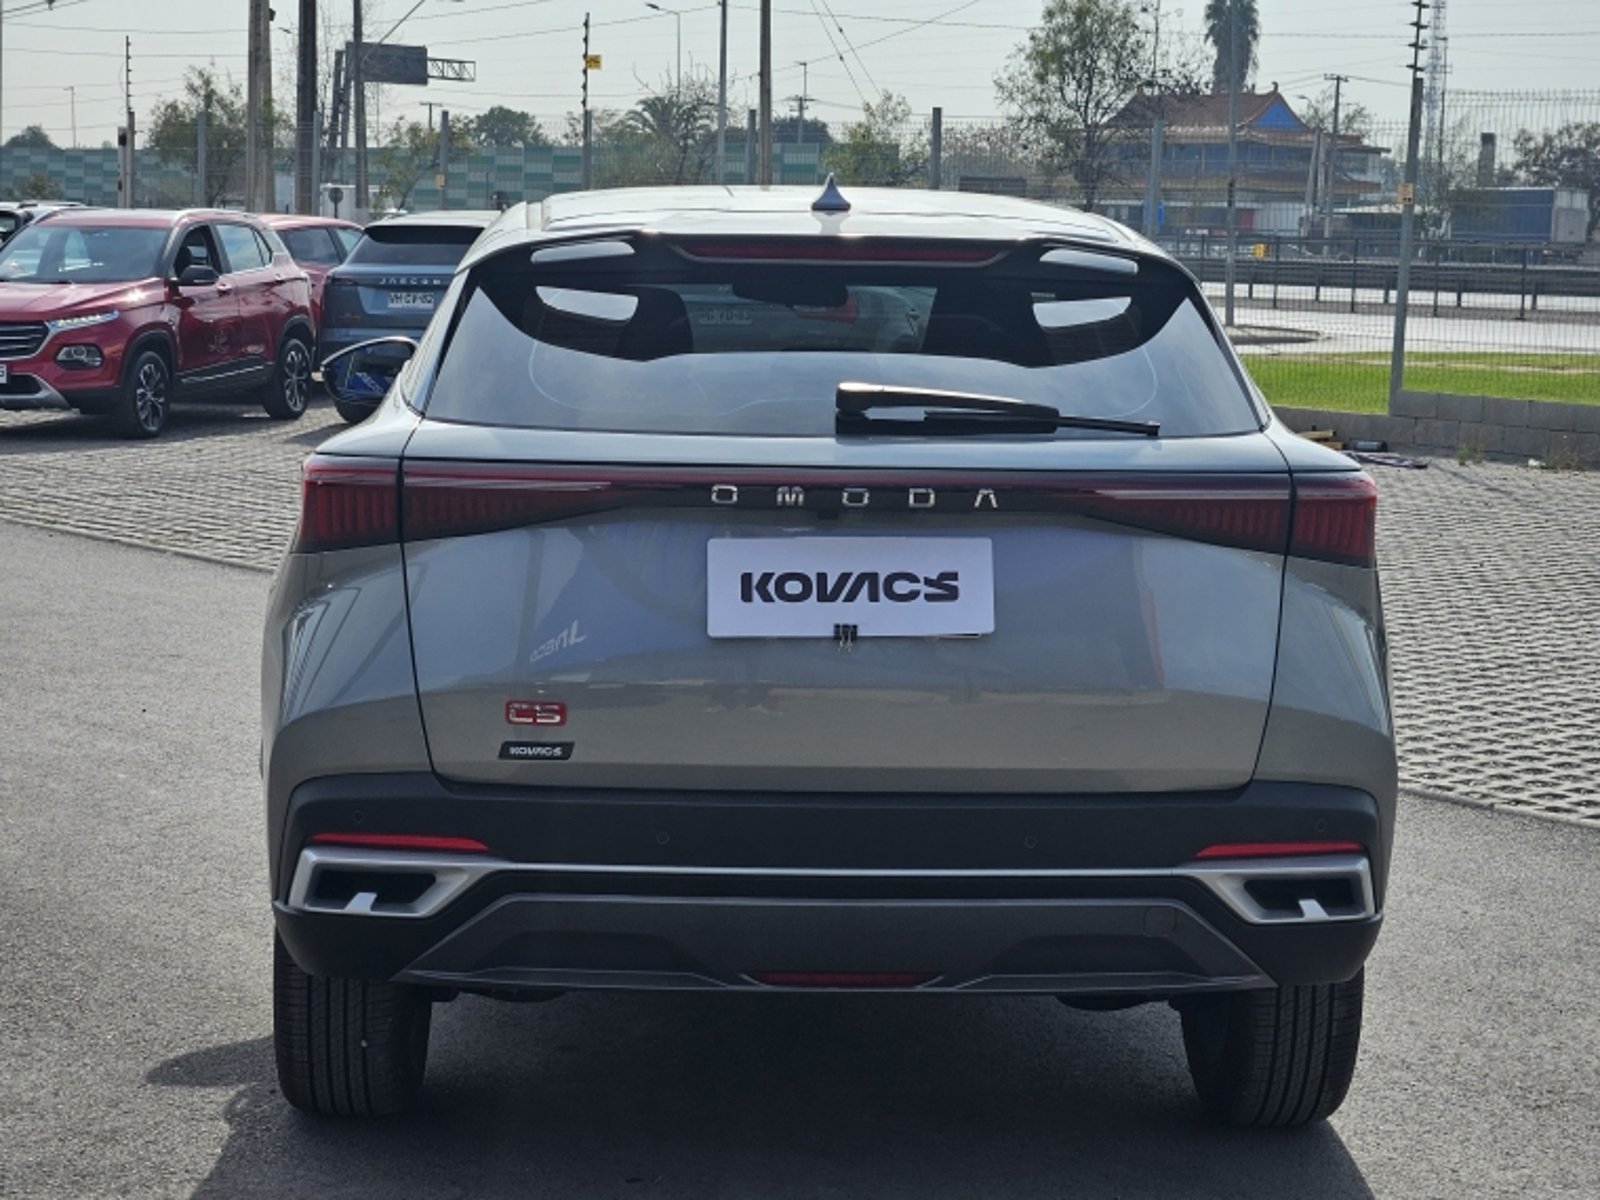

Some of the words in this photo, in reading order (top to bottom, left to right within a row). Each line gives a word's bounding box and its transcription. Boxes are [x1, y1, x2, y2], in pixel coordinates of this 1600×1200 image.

[711, 485, 998, 508] OMODA
[740, 571, 960, 603] KOVACS
[509, 746, 563, 757] KOVACS
